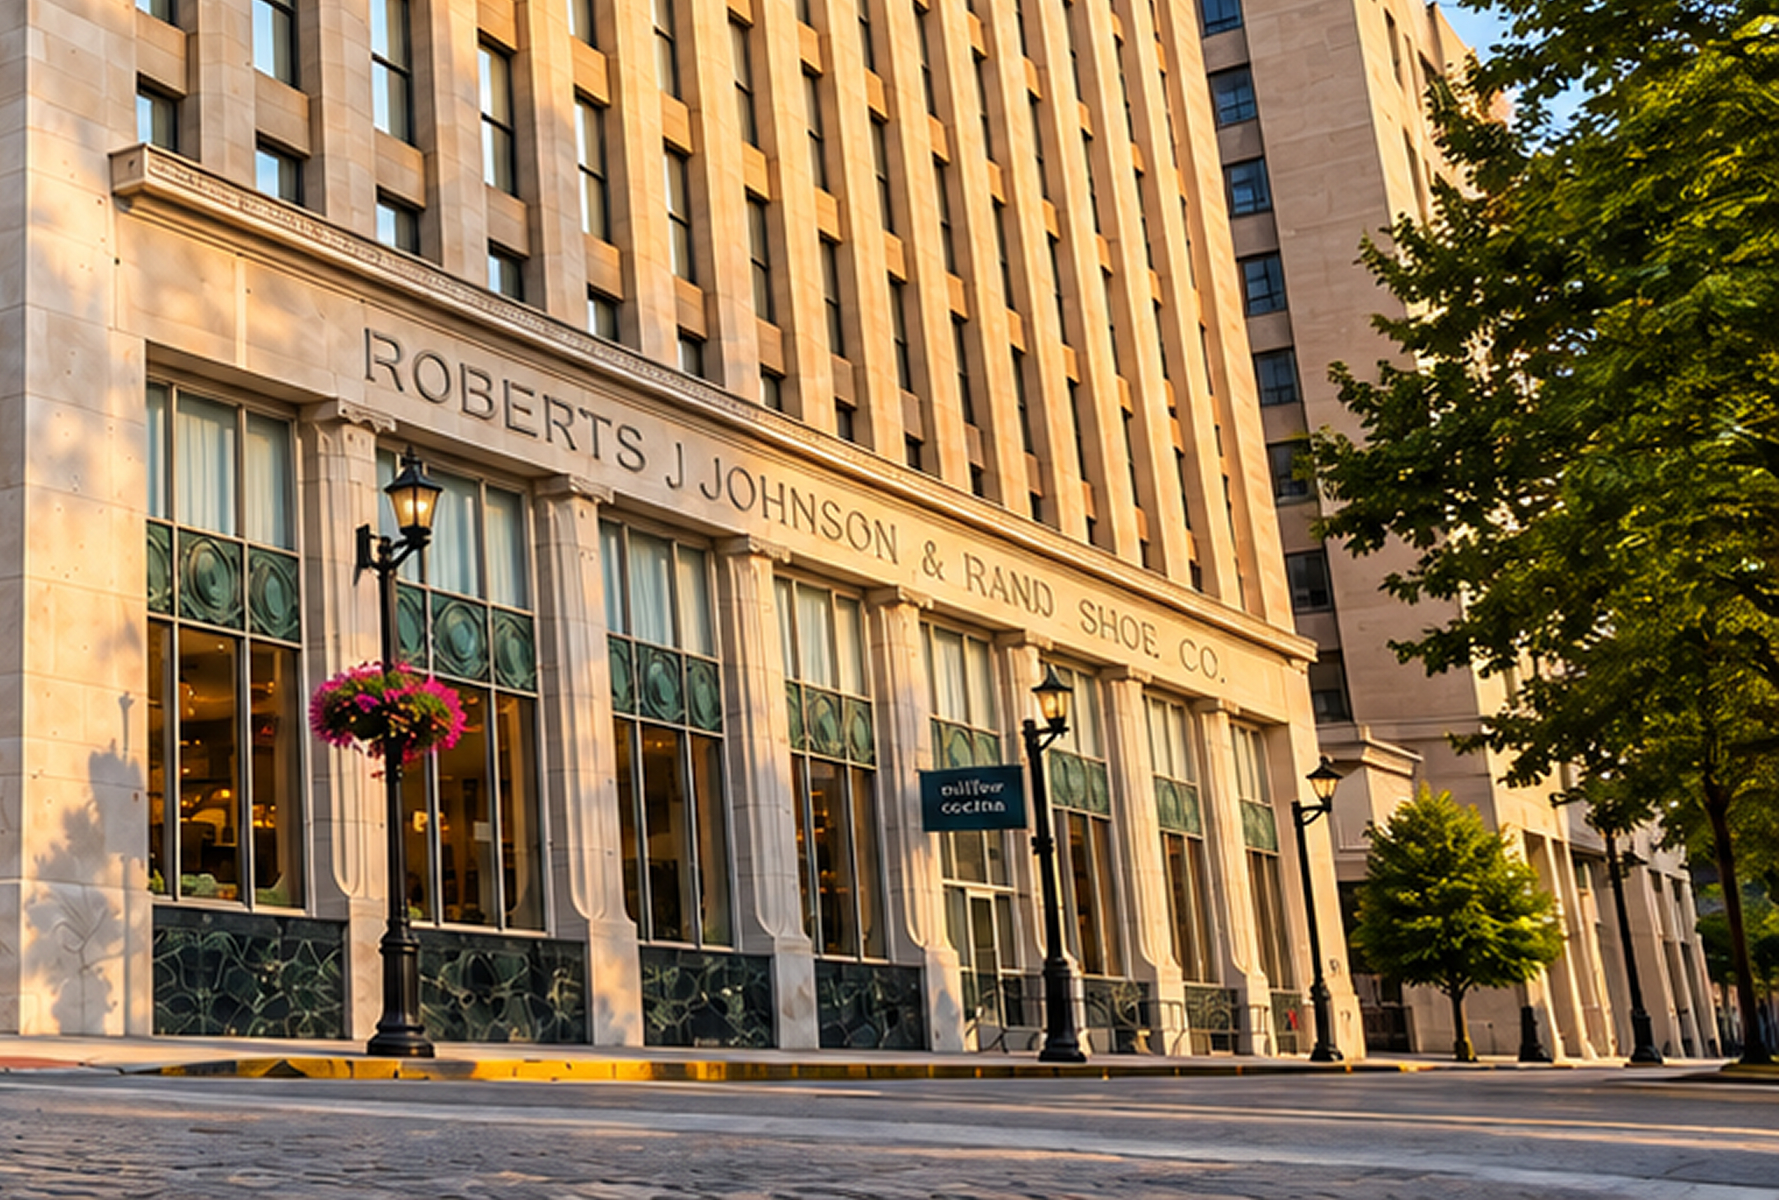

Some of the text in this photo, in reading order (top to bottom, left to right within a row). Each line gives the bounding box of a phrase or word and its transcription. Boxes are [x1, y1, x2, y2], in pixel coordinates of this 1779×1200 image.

[364, 327, 647, 474] ROBERTS
[665, 442, 683, 490] J
[700, 457, 899, 566] JOHNSON
[922, 540, 944, 581] &
[963, 552, 1054, 618] RAND
[1179, 638, 1225, 684] CO.
